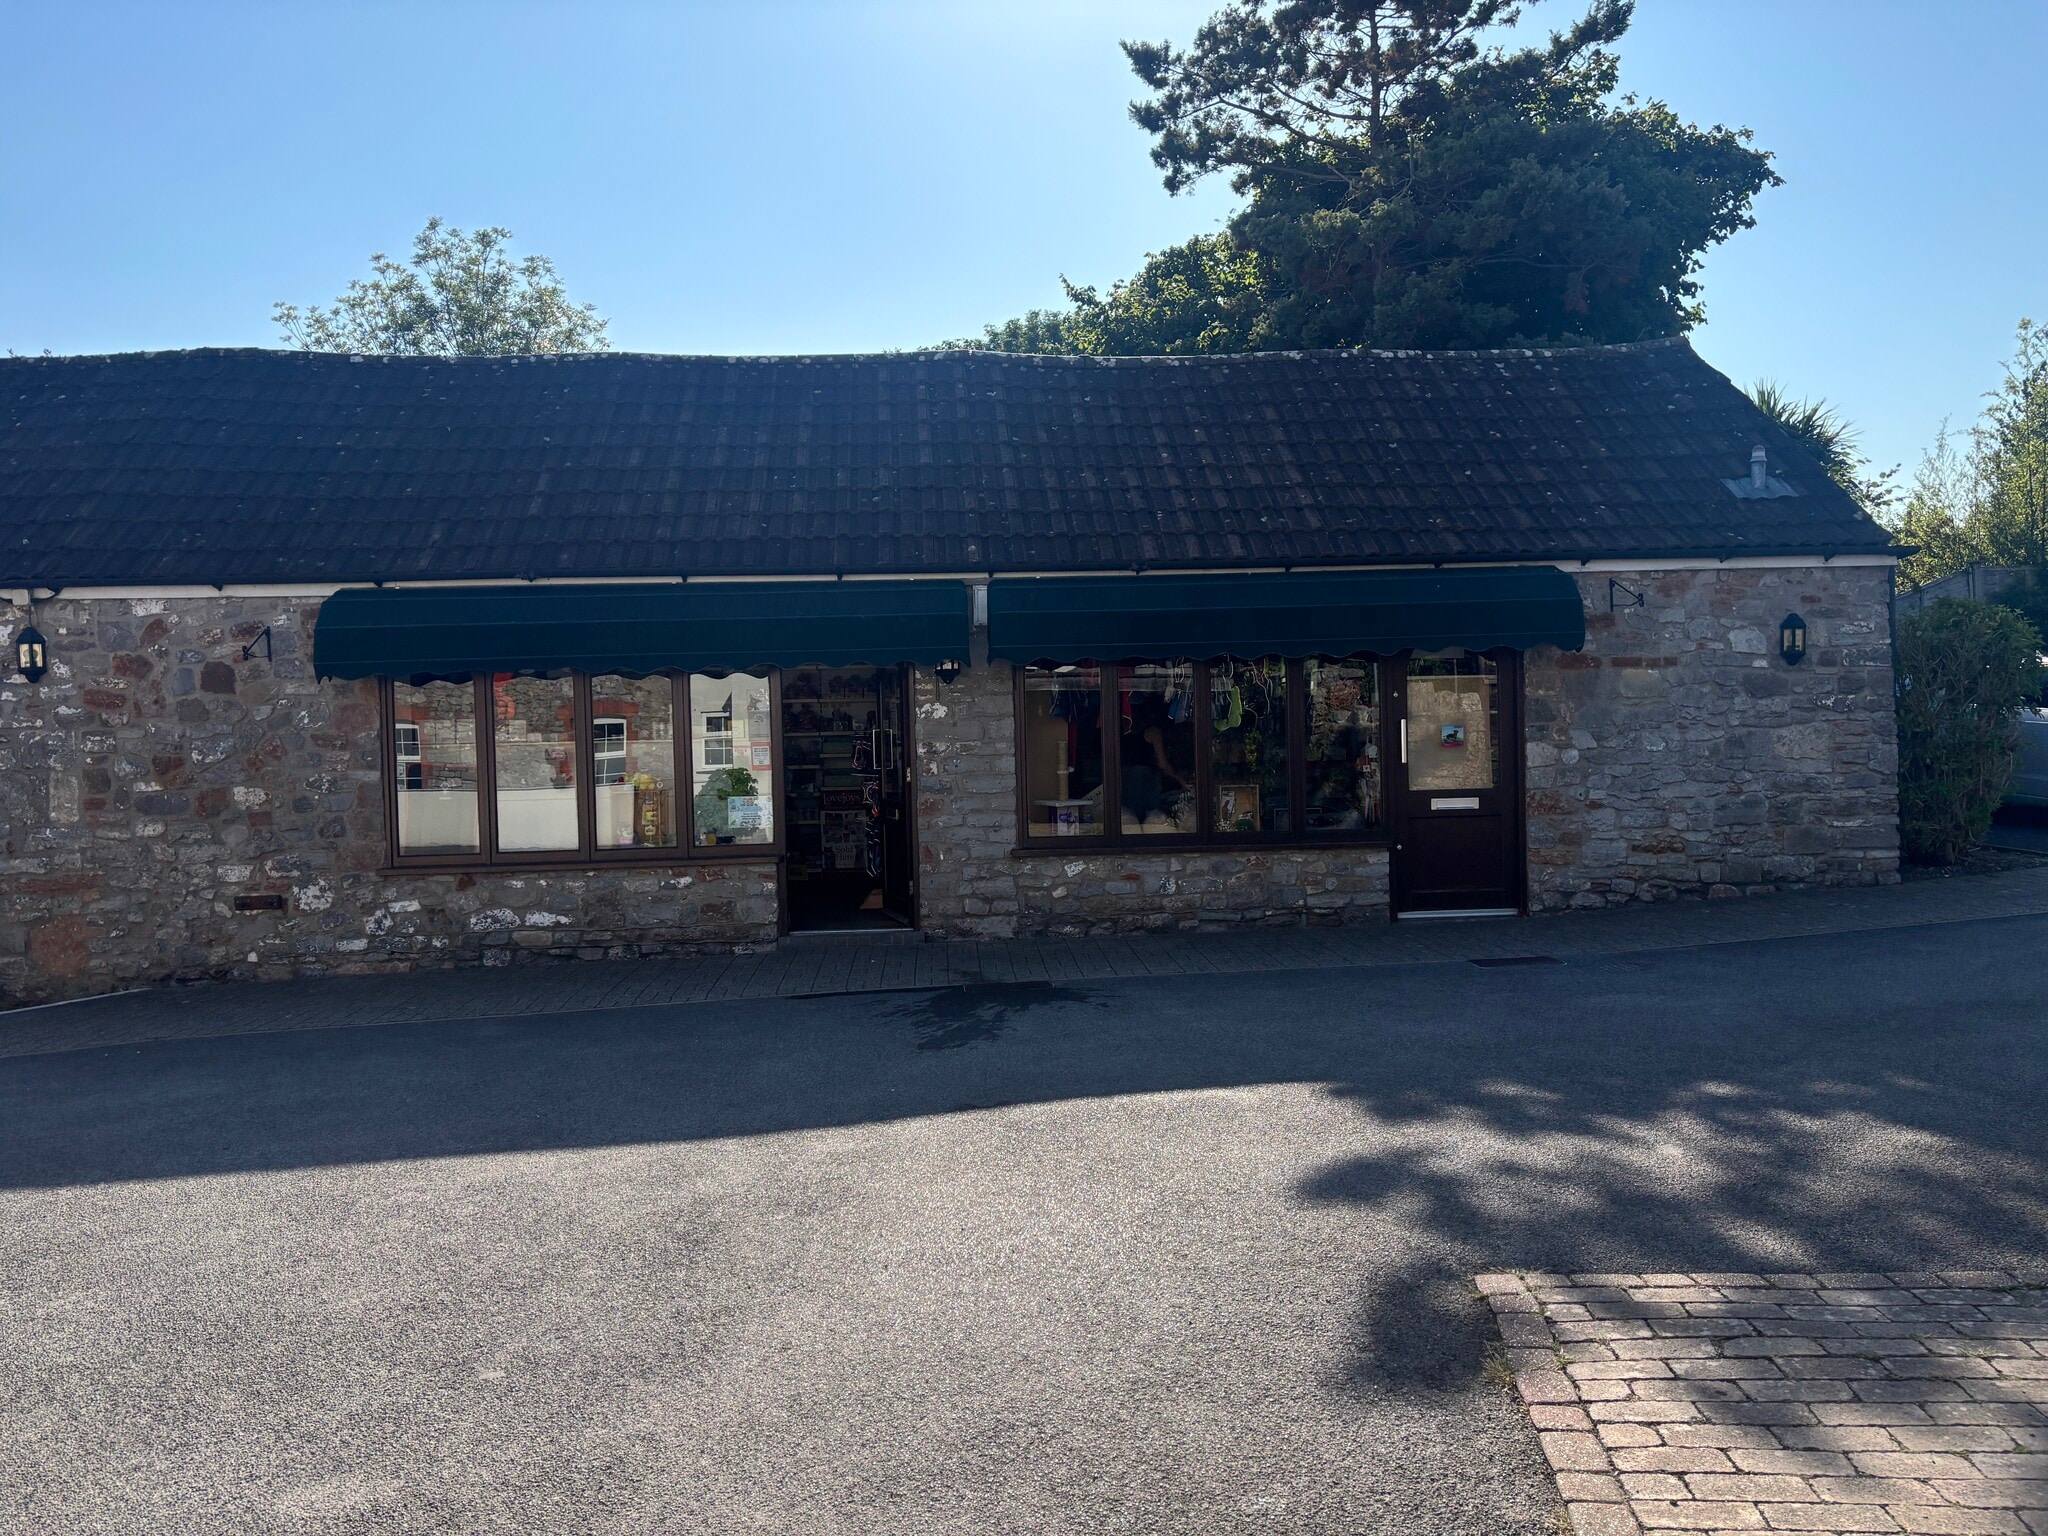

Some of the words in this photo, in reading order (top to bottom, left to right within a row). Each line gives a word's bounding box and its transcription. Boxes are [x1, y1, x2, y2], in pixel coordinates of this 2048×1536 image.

[823, 792, 861, 806] Lovejoys
[835, 845, 853, 853] Sold
[836, 853, 855, 861] Here
